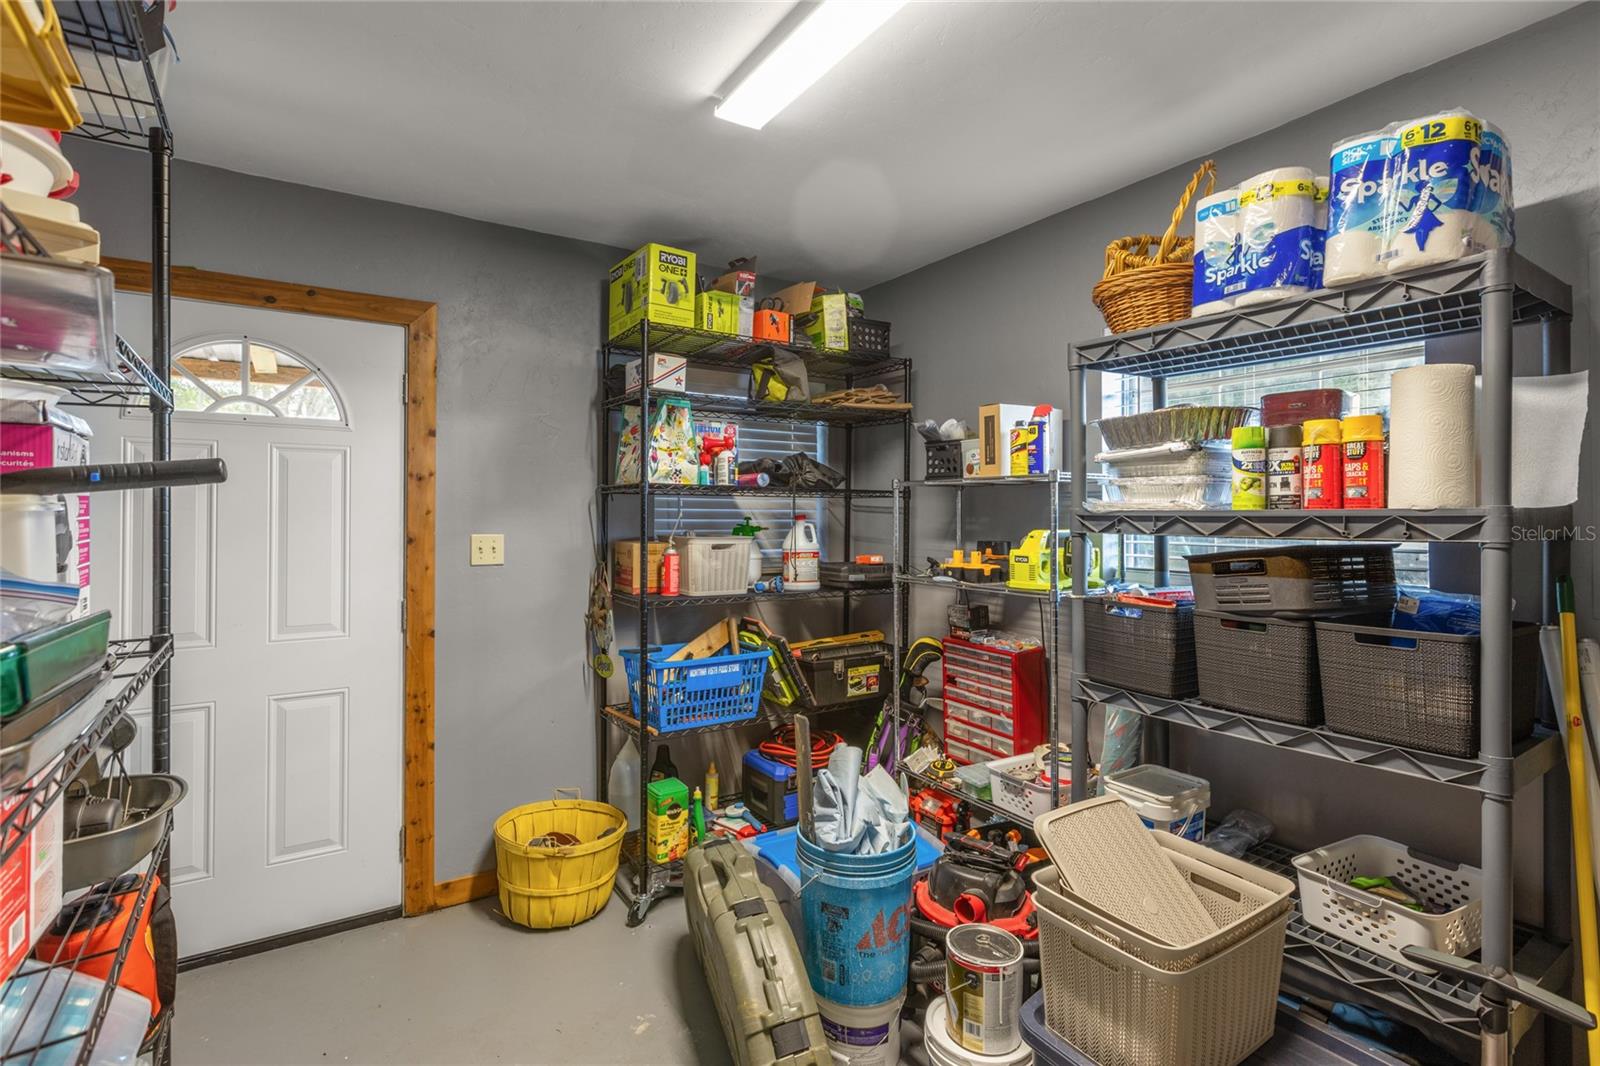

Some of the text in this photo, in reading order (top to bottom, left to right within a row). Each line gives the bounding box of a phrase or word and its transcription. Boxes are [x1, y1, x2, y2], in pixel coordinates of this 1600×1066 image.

[1405, 129, 1416, 141] 6
[1420, 122, 1447, 139] 12
[660, 252, 686, 266] RYOBI
[1205, 252, 1272, 286] Sparkle
